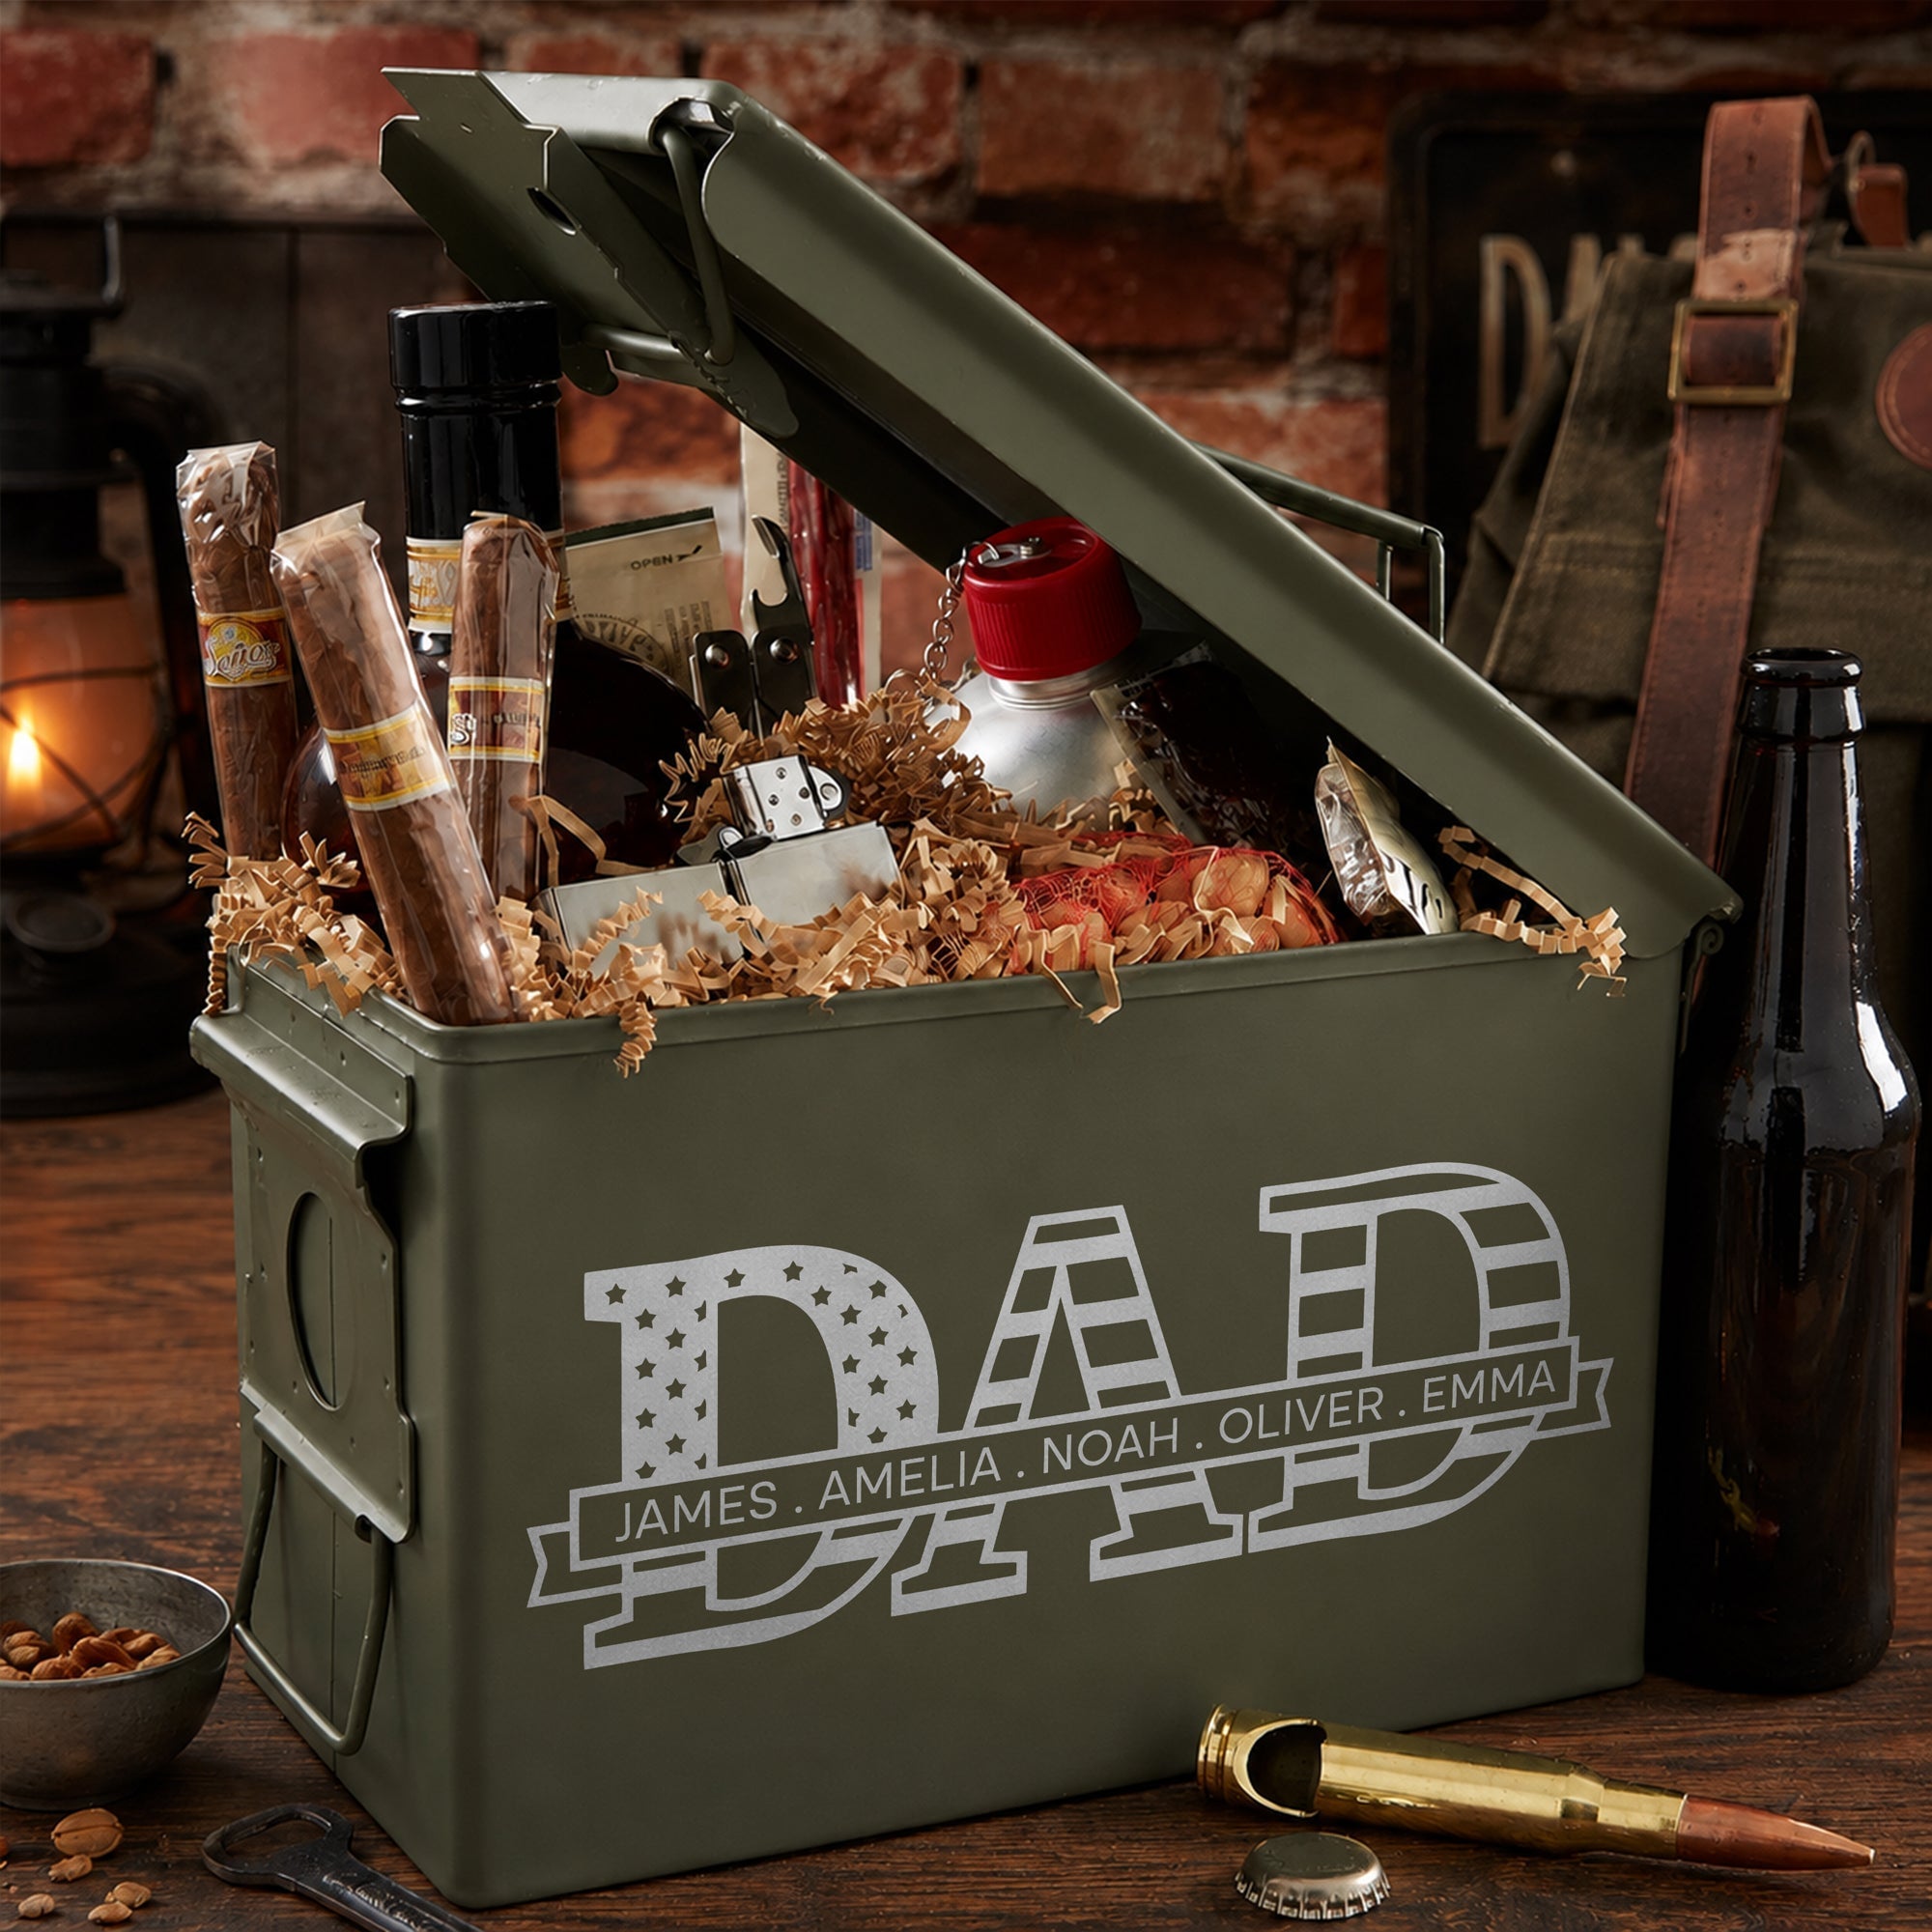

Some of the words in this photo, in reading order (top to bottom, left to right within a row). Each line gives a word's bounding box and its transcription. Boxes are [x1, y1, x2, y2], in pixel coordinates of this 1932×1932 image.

[630, 554, 674, 571] OPEN
[583, 1162, 1571, 1670] DAD
[614, 1480, 778, 1543] JAMES
[818, 1446, 1002, 1510] AMELIA
[1042, 1417, 1179, 1474] NOAH
[1219, 1386, 1385, 1444] OLIVER
[1423, 1359, 1556, 1413] EMMA
